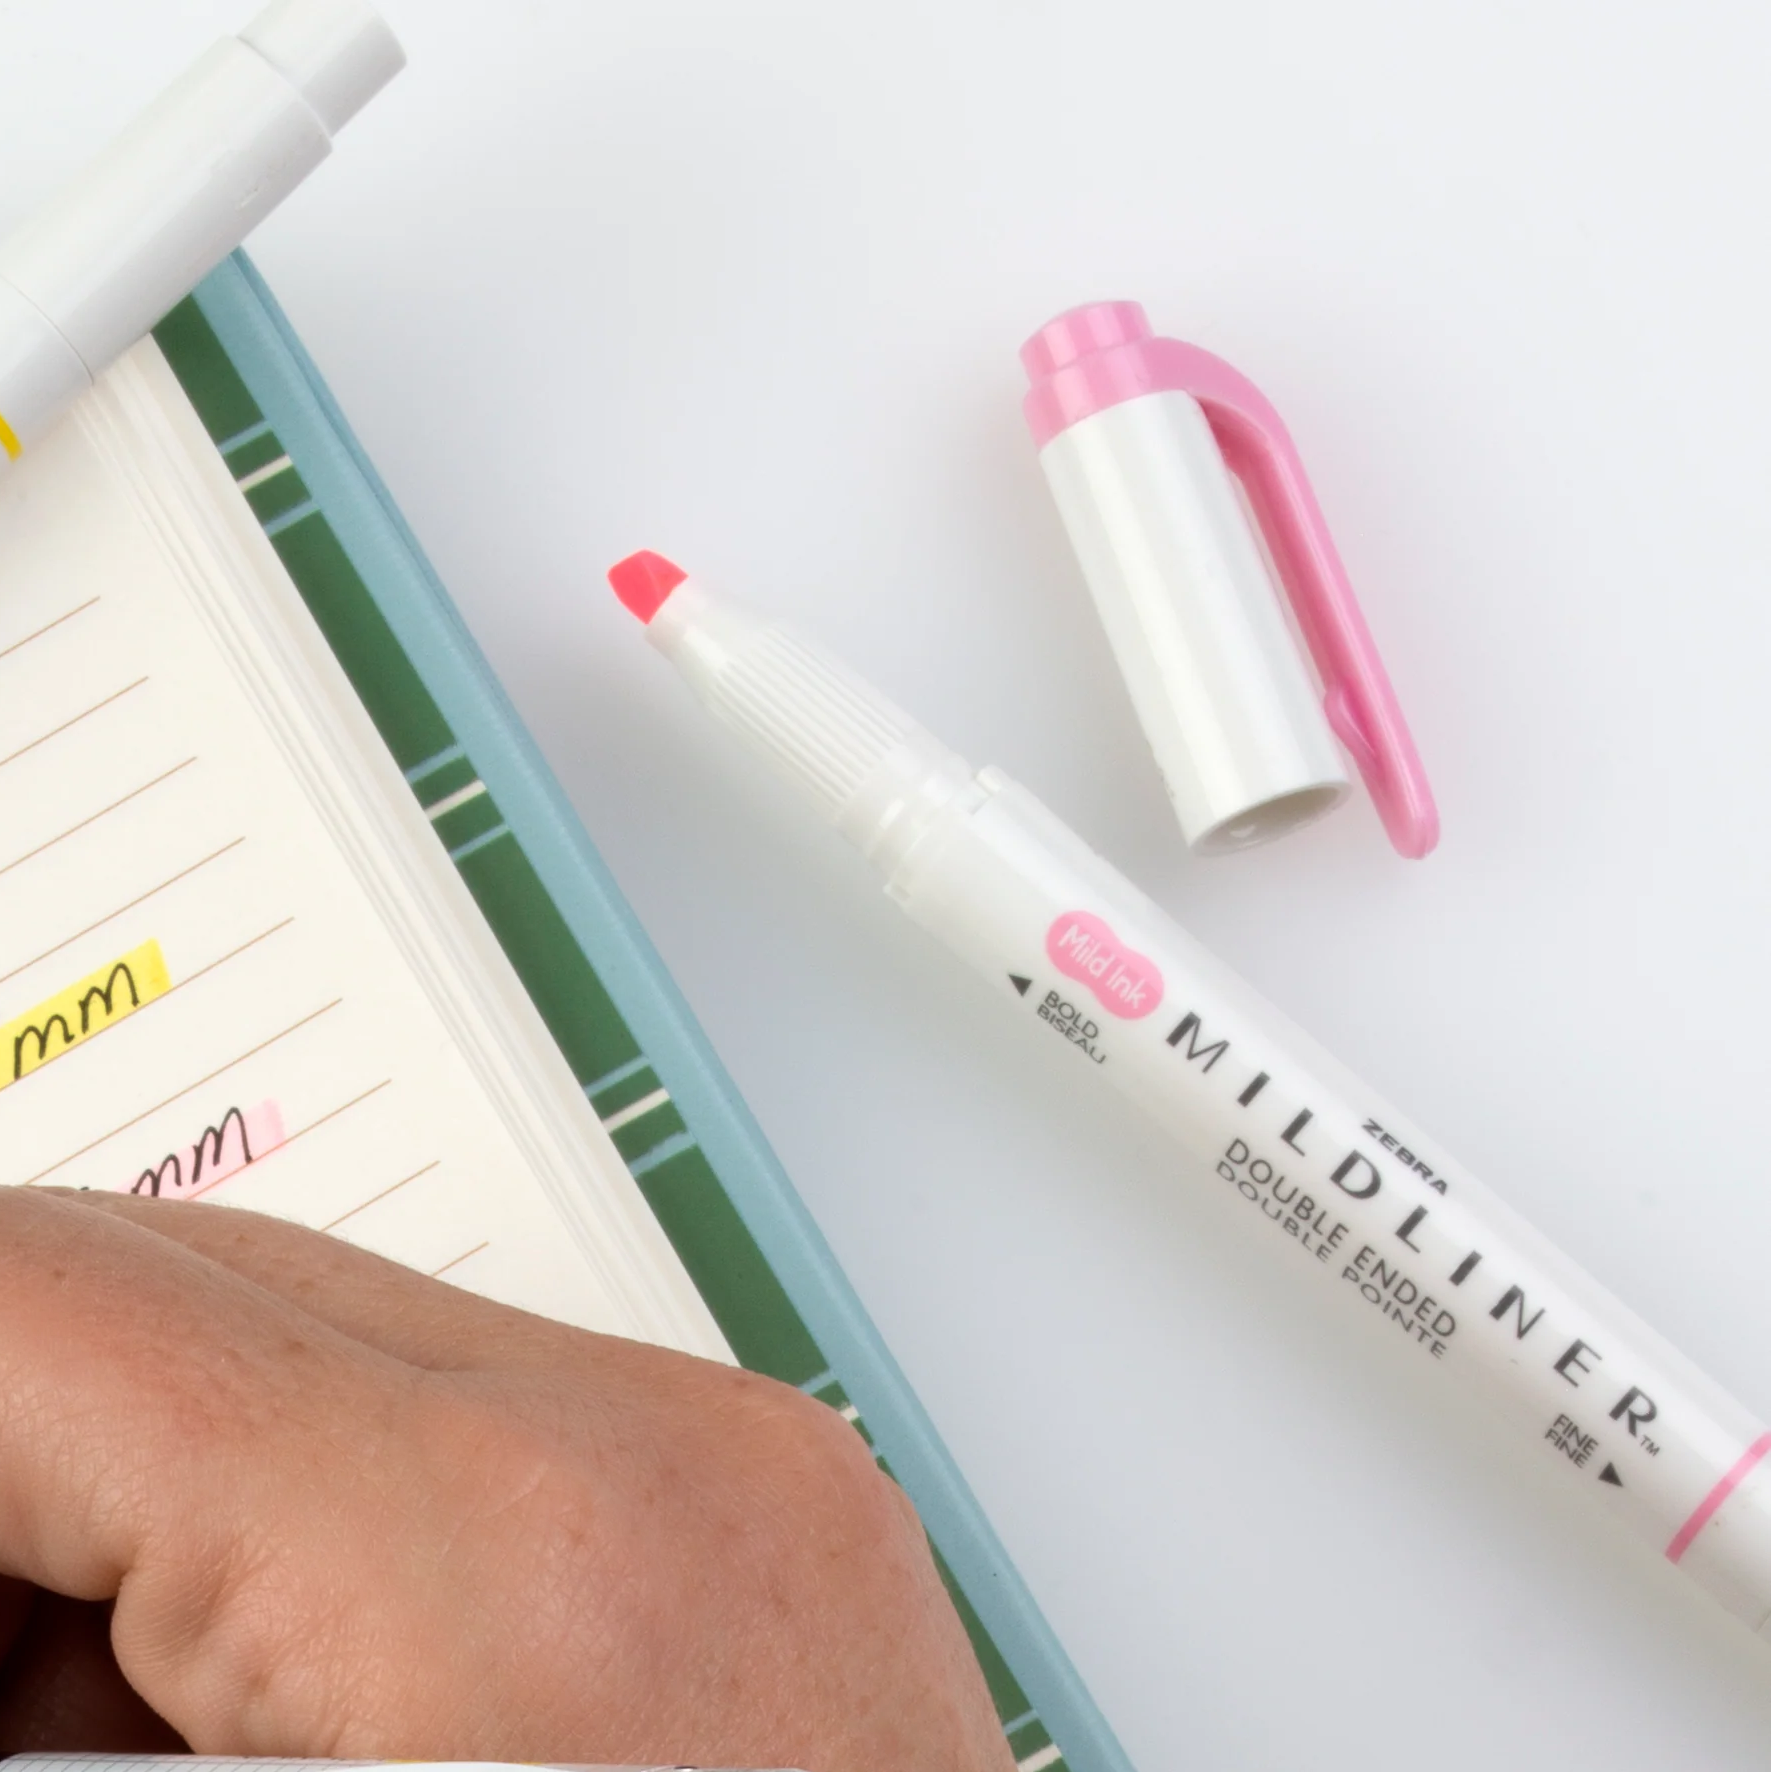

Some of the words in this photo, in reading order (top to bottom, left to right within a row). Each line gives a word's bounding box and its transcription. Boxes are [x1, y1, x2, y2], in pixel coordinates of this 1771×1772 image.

[1057, 923, 1115, 979] Mild
[1104, 964, 1146, 1010] Ink
[1035, 1003, 1107, 1065] BISEAU
[1043, 989, 1100, 1040] BOLD
[1361, 1117, 1449, 1197] ZEBRA
[1215, 1160, 1333, 1264] DOUBLE
[1341, 1264, 1448, 1360] POINTE
[1225, 1137, 1350, 1249] DOUBLE
[1352, 1244, 1457, 1338] ENDED
[1544, 1427, 1585, 1470] FINE
[1552, 1413, 1600, 1458] FINE
